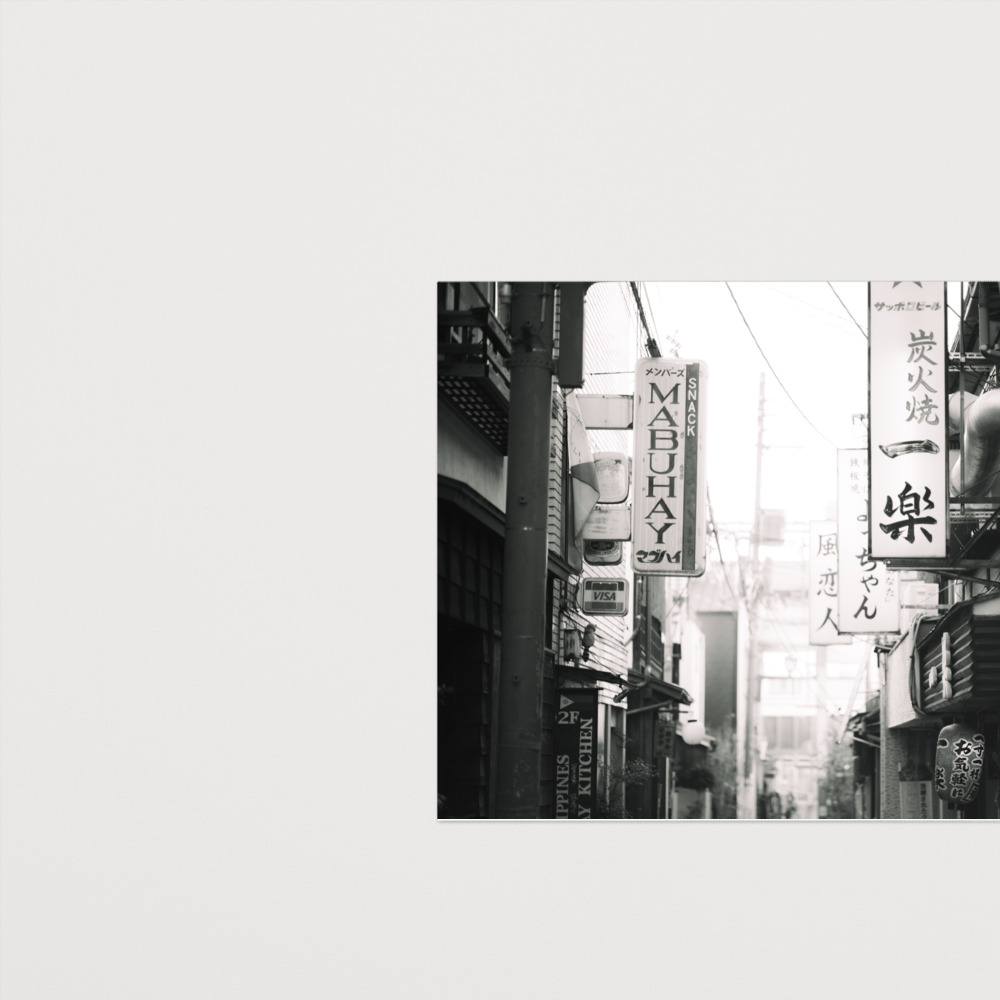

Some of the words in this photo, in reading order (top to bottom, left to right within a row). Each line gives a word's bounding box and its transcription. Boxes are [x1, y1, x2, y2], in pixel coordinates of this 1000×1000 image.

[873, 301, 941, 311] サッポロビール
[645, 367, 686, 378] メンバーズ
[906, 329, 940, 426] 炭火焼
[687, 377, 698, 437] SNACK
[644, 382, 681, 544] MABUHAY
[879, 439, 940, 544] 一楽
[593, 591, 616, 601] VISA
[558, 711, 579, 725] 2F
[578, 718, 593, 796] KITCHEN
[951, 738, 972, 798] お気軽に
